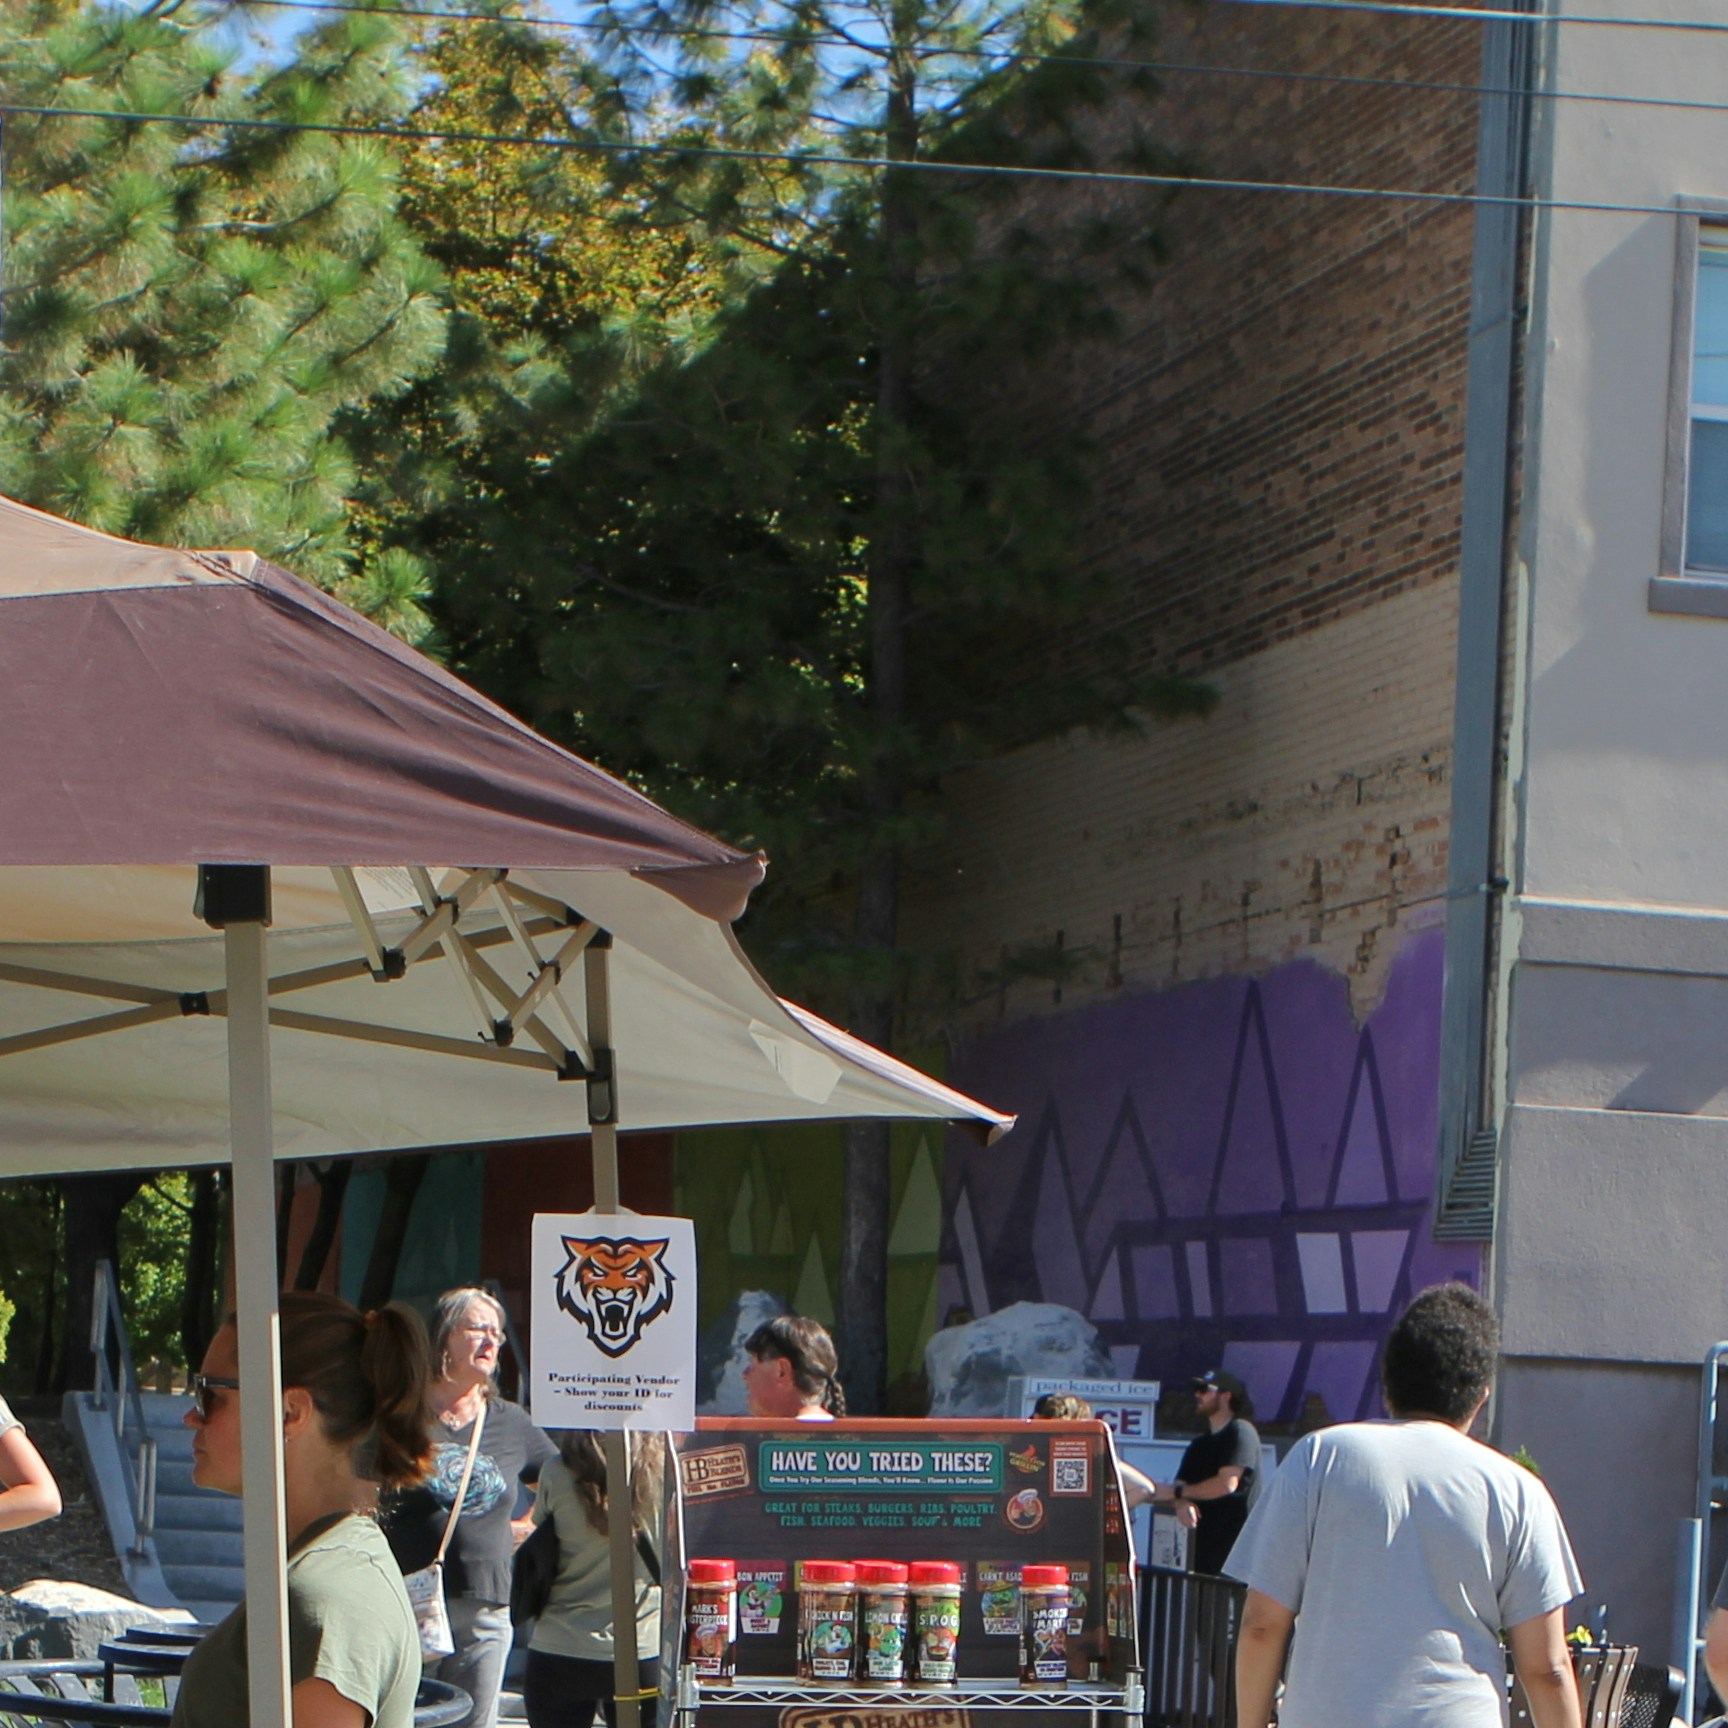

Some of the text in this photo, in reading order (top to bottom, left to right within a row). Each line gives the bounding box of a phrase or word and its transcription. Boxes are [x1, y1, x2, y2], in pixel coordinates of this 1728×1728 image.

[548, 1372, 680, 1385] Participating Vendor
[1036, 1380, 1153, 1393] packaged ice
[565, 1387, 597, 1397] Show
[601, 1390, 629, 1399] your
[635, 1388, 650, 1398] ID
[655, 1388, 673, 1398] for
[584, 1401, 643, 1411] discounts
[771, 1451, 817, 1472] HAVE
[824, 1451, 860, 1472] YOU
[869, 1451, 923, 1472] TRIED
[931, 1451, 993, 1472] THESE?
[798, 1476, 810, 1485] Try
[765, 1503, 797, 1514] GREAT
[801, 1503, 820, 1514] FOR
[953, 1516, 982, 1527] MORE
